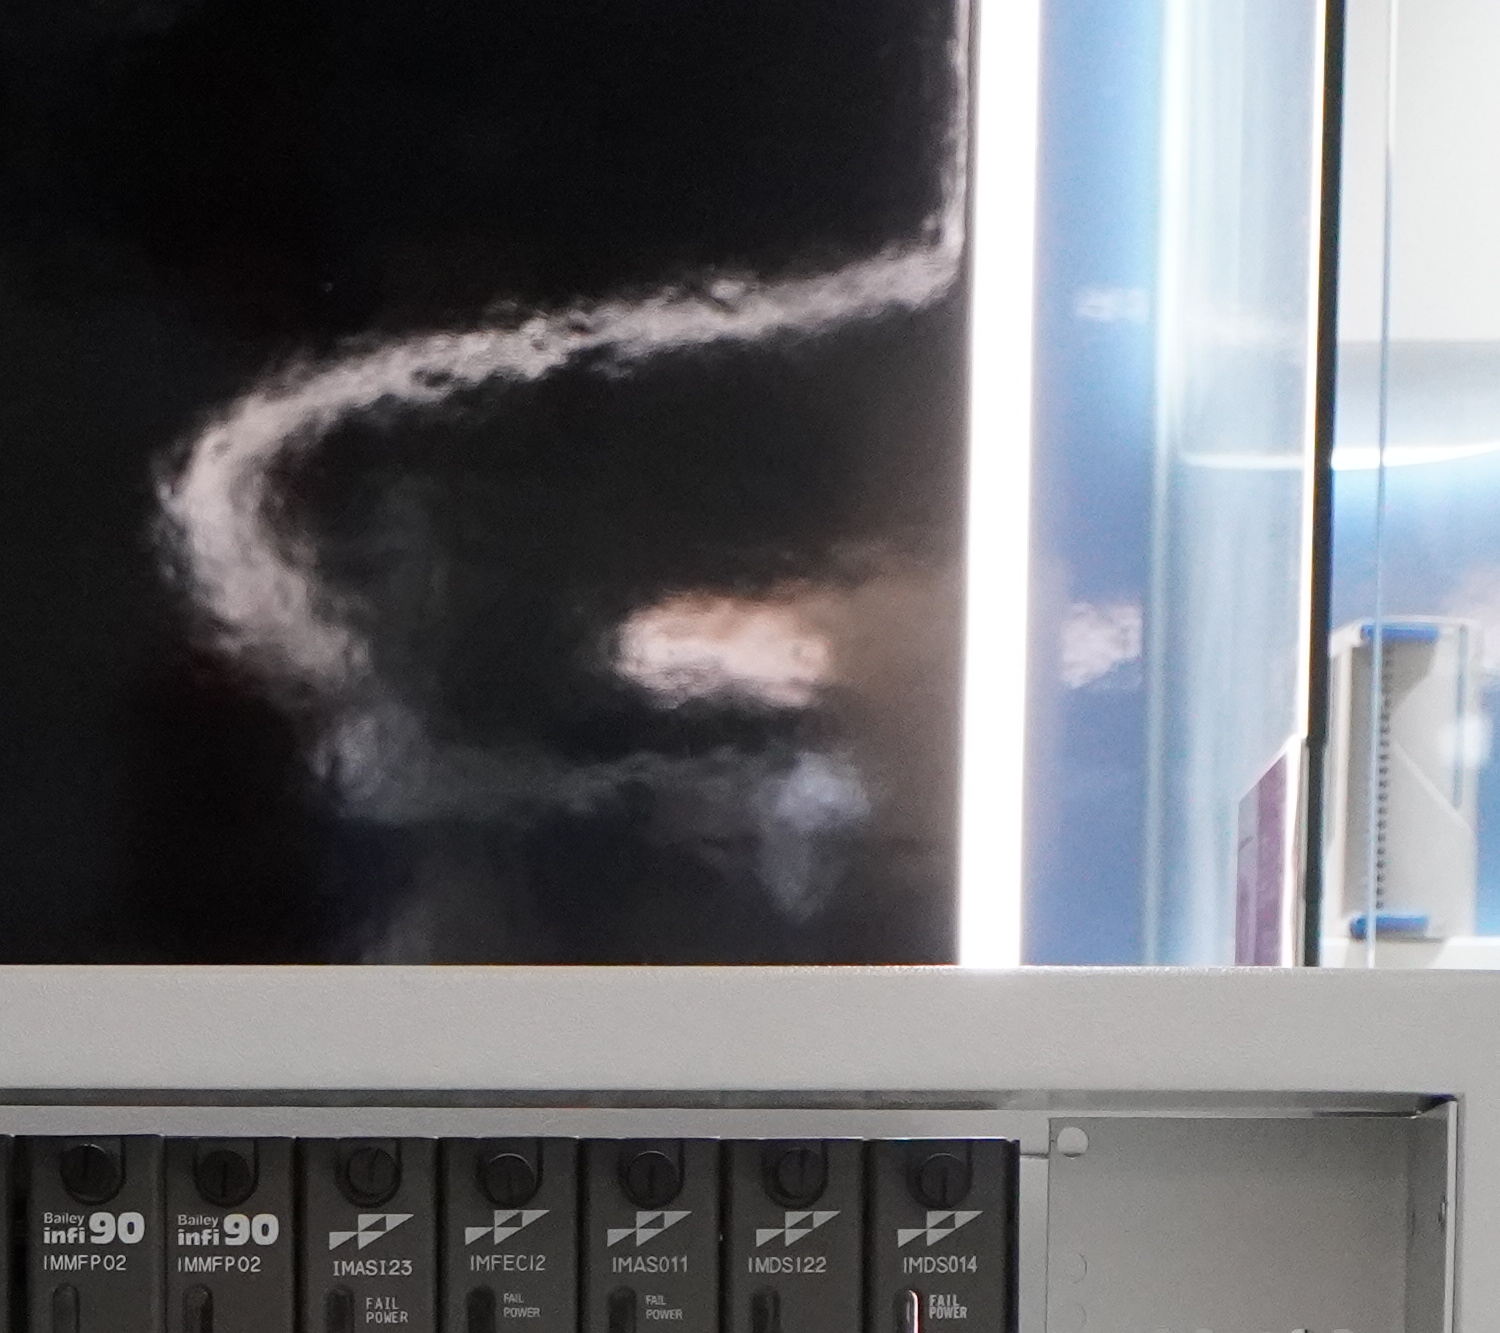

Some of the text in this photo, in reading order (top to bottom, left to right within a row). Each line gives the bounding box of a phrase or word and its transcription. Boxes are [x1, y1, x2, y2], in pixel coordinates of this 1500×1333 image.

[43, 1211, 85, 1227] Bailey
[177, 1214, 219, 1228] Bailey
[44, 1211, 145, 1245] infi 90
[178, 1214, 278, 1245] infi 90
[43, 1254, 127, 1271] IMMFP02
[177, 1255, 261, 1273] IMMFP02
[365, 1296, 399, 1310] FAIL
[503, 1292, 524, 1304] FAIL
[645, 1294, 666, 1306] FAIL
[929, 1294, 959, 1307] FAIL
[366, 1310, 408, 1324] POWER
[503, 1306, 541, 1318] POWER
[645, 1308, 683, 1320] POWER
[929, 1306, 967, 1319] POWER
